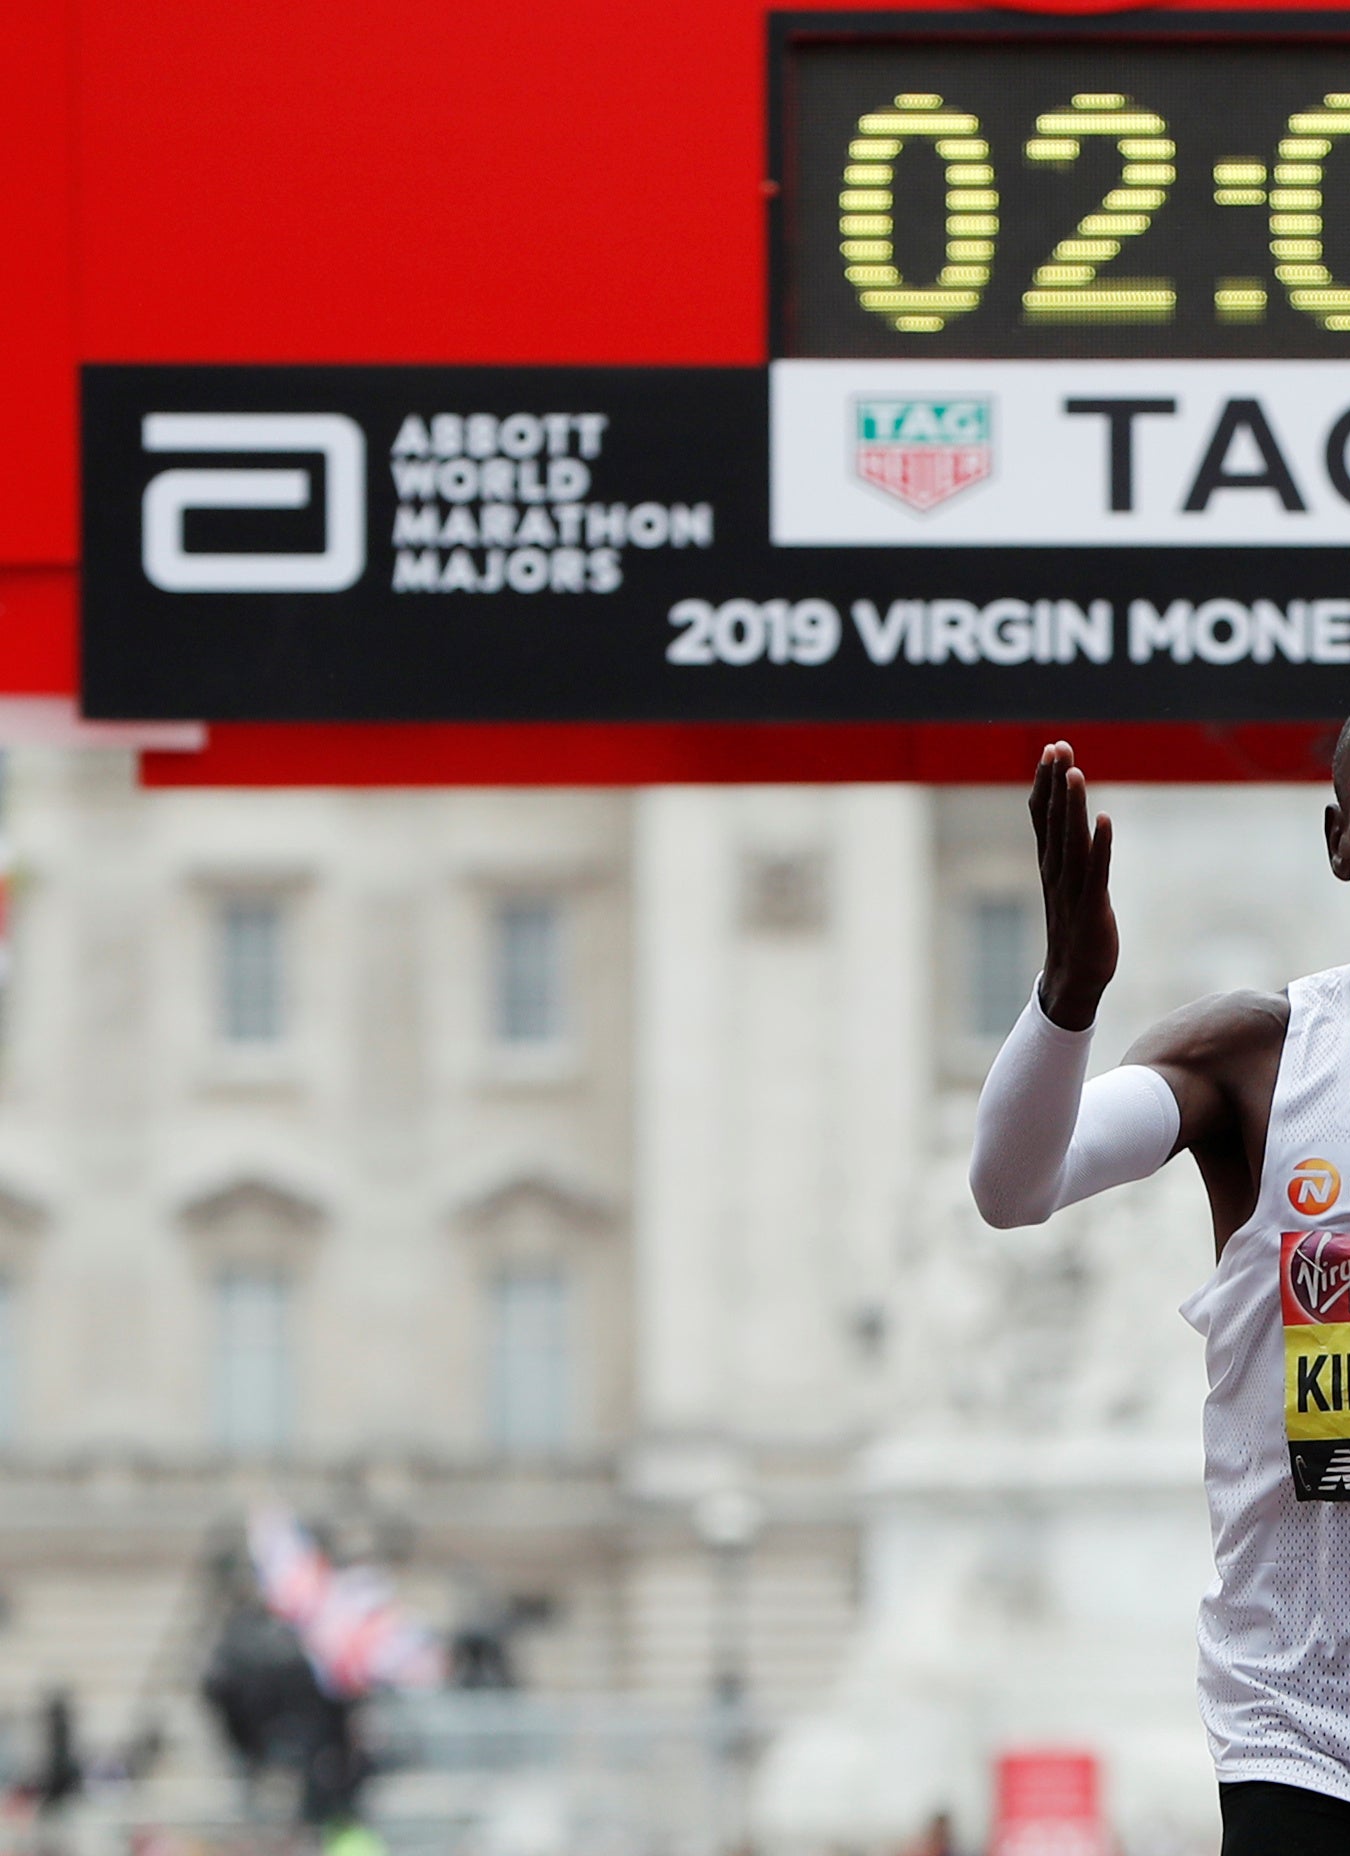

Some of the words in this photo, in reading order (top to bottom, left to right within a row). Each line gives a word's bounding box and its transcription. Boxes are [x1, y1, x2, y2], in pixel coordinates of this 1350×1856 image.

[391, 413, 608, 457] ABBOTT
[861, 403, 984, 442] TAG
[391, 459, 592, 503] WORLD
[391, 503, 714, 548] MARATHON
[391, 550, 623, 595] MAJORS
[666, 598, 842, 666] 2019
[851, 598, 1114, 665] VIRGIN
